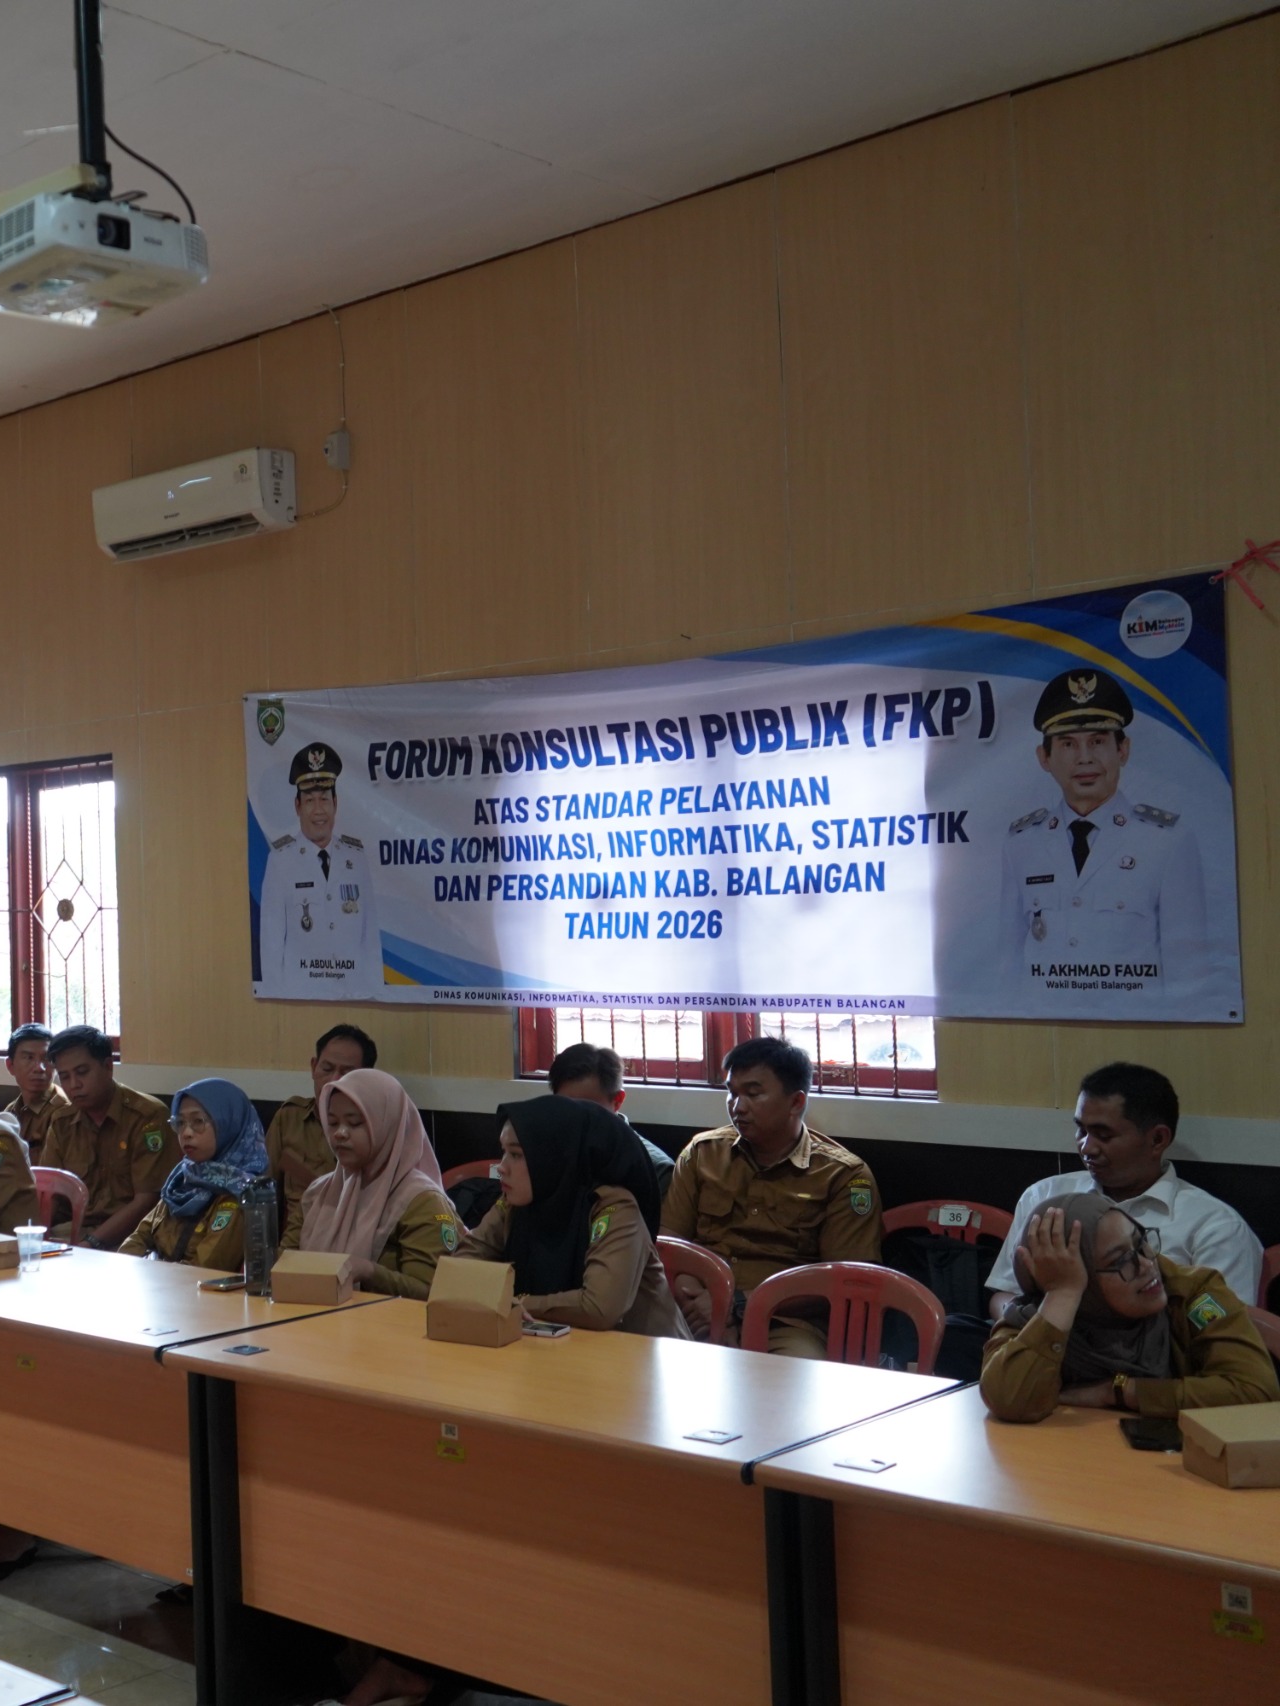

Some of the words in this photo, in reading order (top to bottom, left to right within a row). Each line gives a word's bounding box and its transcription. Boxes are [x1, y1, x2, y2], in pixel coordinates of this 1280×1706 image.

[1127, 620, 1157, 634] KIM
[369, 736, 472, 781] FORUM
[478, 717, 695, 775] KONSULTASI
[700, 700, 849, 758] PUBLIK
[864, 681, 995, 747] (FKP)
[474, 797, 529, 825] ATAS
[536, 790, 653, 822] STANDAR
[659, 776, 830, 815] PELAYANAN
[379, 838, 445, 865] DINAS
[451, 833, 603, 864] KOMUNIKASI,
[608, 821, 803, 858] INFORMATIKA,
[811, 810, 970, 850] STATISTIK
[434, 874, 481, 902] DAN
[487, 871, 646, 901] PERSANDIAN
[654, 868, 718, 898] KAB.
[726, 861, 885, 896] BALANGAN
[565, 911, 649, 939] TAHUN
[657, 910, 722, 939] 2026
[300, 960, 308, 969] H.
[309, 960, 334, 969] ABDUL
[335, 960, 355, 969] HADI
[1031, 964, 1045, 977] H.
[1048, 964, 1111, 977] AKHMAD
[1115, 964, 1158, 977] FAUZI
[1046, 980, 1069, 989] Wakil
[1071, 980, 1099, 991] Bupati
[1101, 980, 1143, 991] Balangan
[433, 990, 462, 1000] DINAS
[464, 991, 526, 1002] KOMUNIKASI,
[529, 993, 599, 1004] INFORMATIKA,
[602, 994, 653, 1004] STATISTIK
[658, 995, 680, 1005] DAN
[684, 996, 756, 1006] PERSANDIAN
[762, 997, 832, 1008] KABUPATEN
[837, 998, 905, 1009] BALANGAN
[949, 1212, 962, 1222] 36
